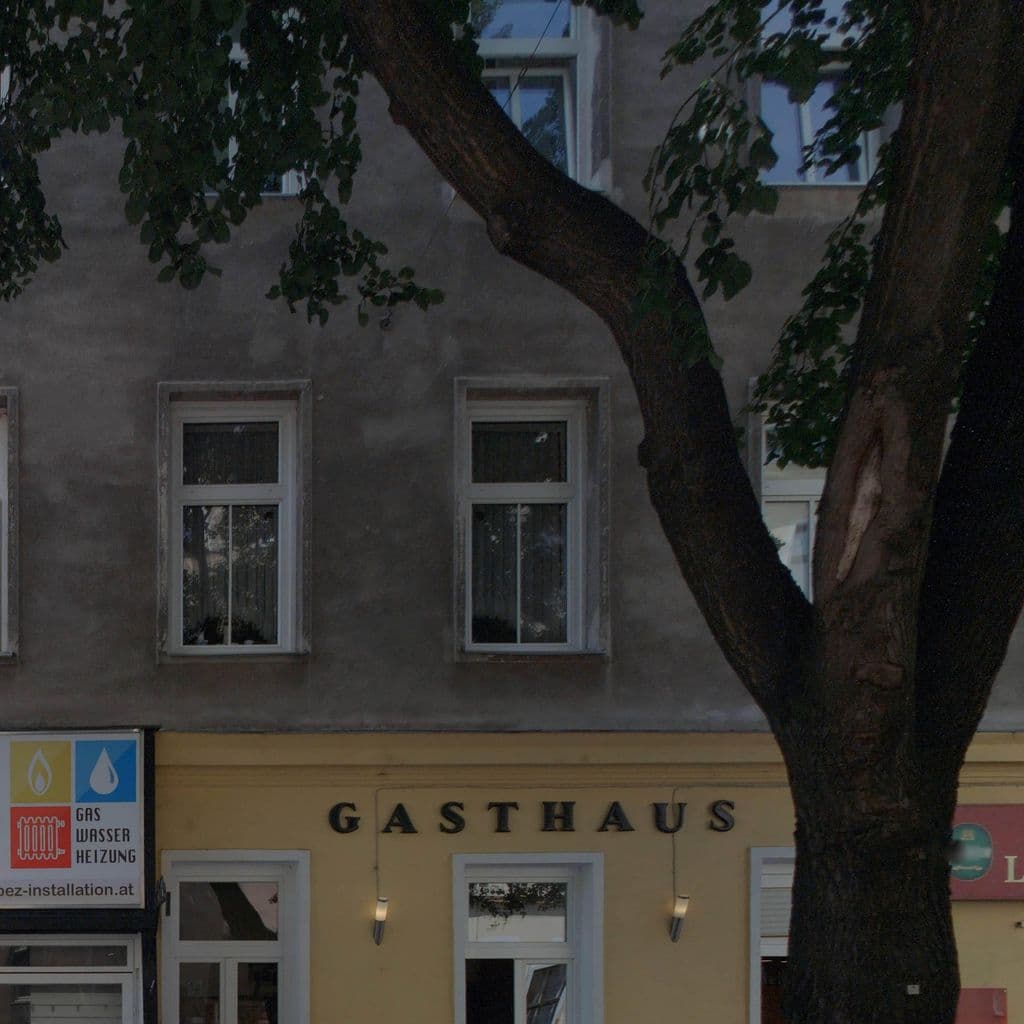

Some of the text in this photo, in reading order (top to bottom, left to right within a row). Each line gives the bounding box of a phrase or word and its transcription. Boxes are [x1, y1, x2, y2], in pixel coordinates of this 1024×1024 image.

[76, 807, 101, 822] GAS
[328, 800, 737, 834] GASTHAUS
[76, 827, 131, 844] WASSER
[76, 848, 137, 865] HEIZUNG
